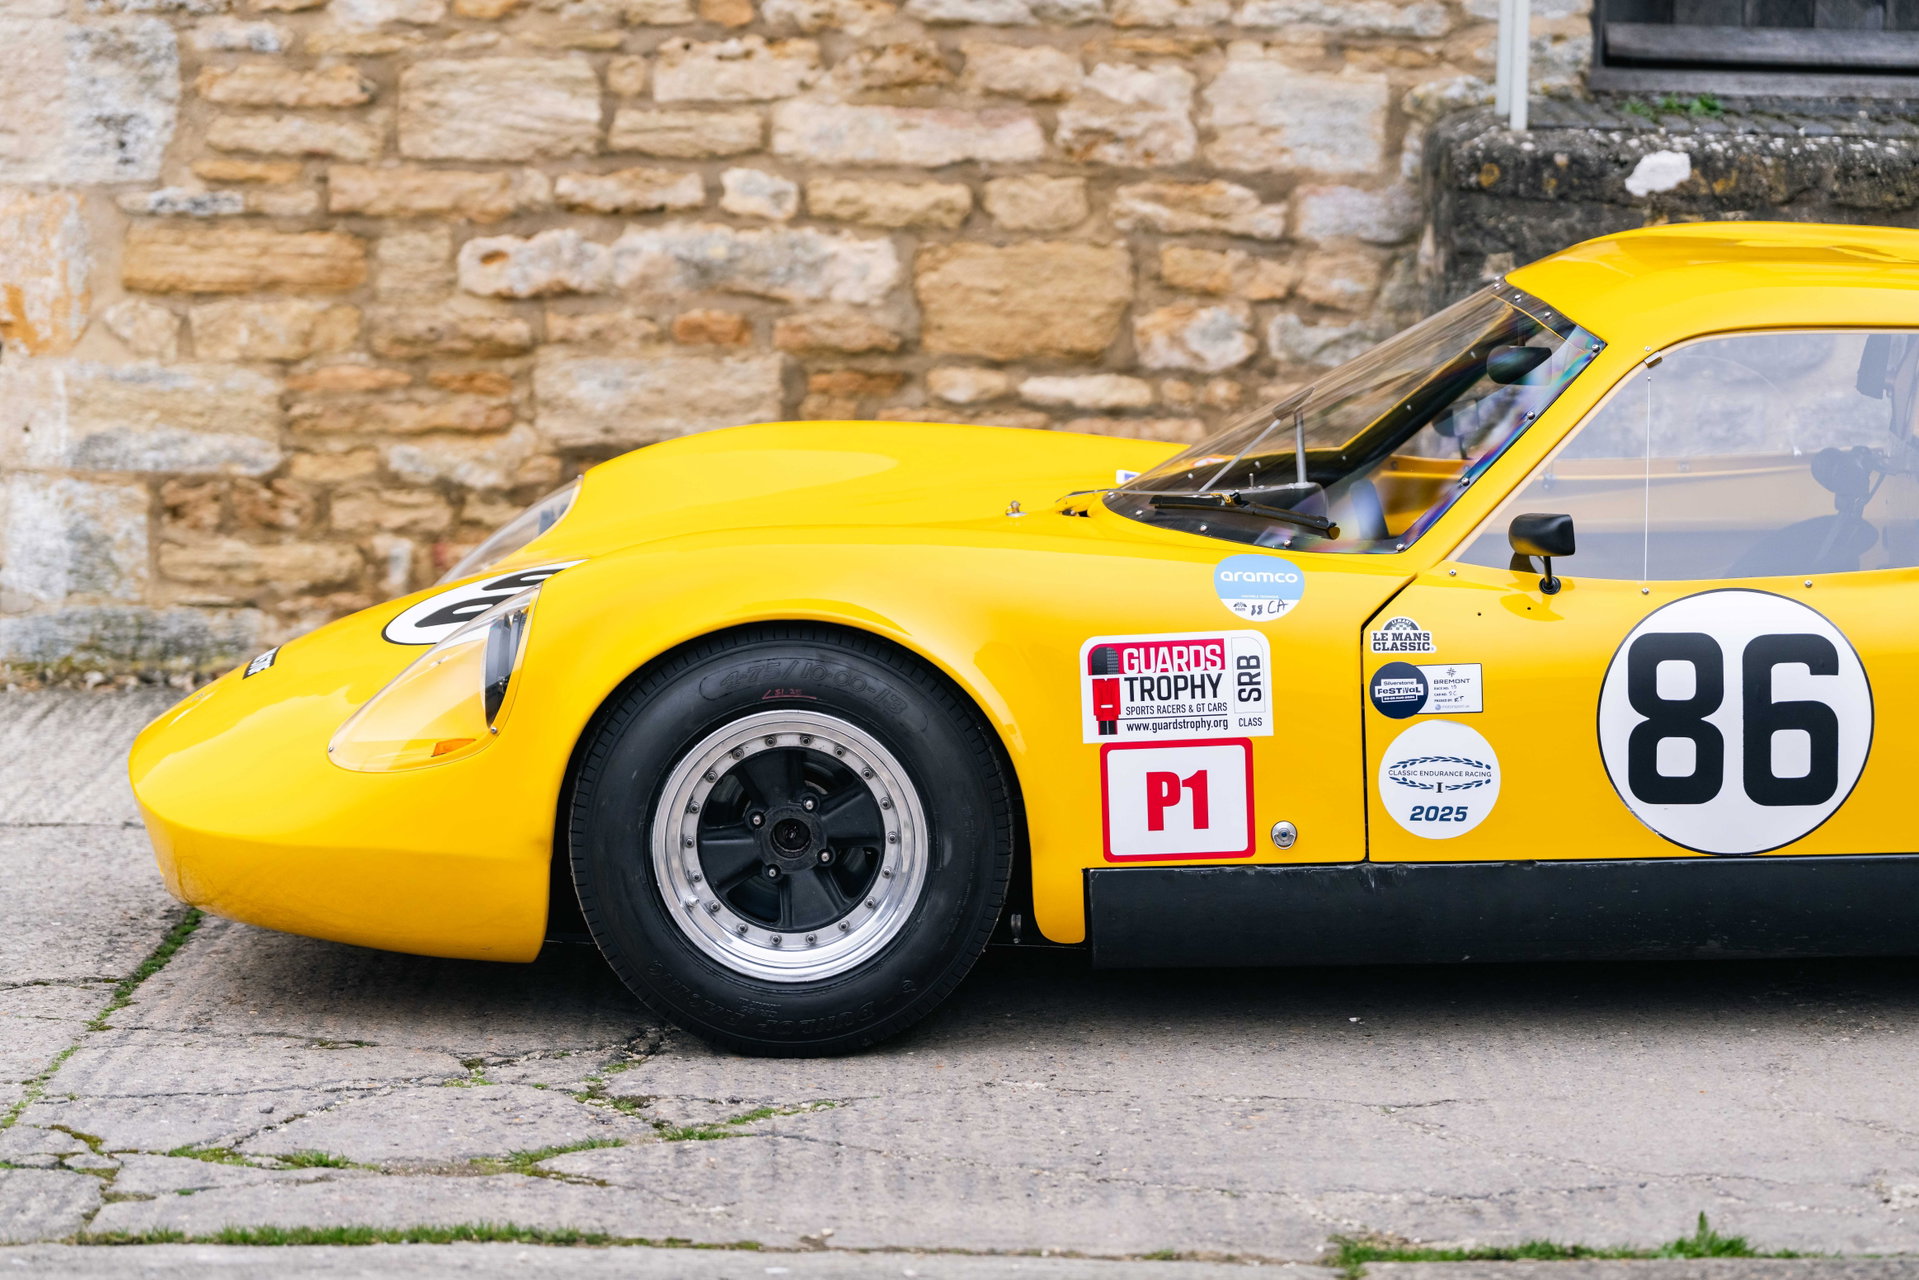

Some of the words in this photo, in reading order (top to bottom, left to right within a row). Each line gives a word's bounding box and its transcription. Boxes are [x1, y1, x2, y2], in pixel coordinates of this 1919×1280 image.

[1220, 571, 1298, 583] aramco
[1373, 632, 1388, 641] LE
[1391, 632, 1430, 641] MANS
[1373, 642, 1430, 651] CLASSIC
[1122, 644, 1222, 674] GUARDS
[1237, 655, 1262, 702] SRB
[1124, 673, 1222, 702] TROPHY
[1126, 705, 1154, 716] SPORTS
[1156, 704, 1186, 714] RACERS
[1188, 703, 1194, 713] &
[1196, 703, 1205, 713] GT
[1207, 702, 1227, 712] CARS
[1126, 718, 1228, 733] www.guardstrophy.org
[1238, 717, 1262, 727] CLASS
[1628, 632, 1839, 806] 86
[1146, 770, 1209, 831] P1
[1409, 805, 1468, 822] 2025
